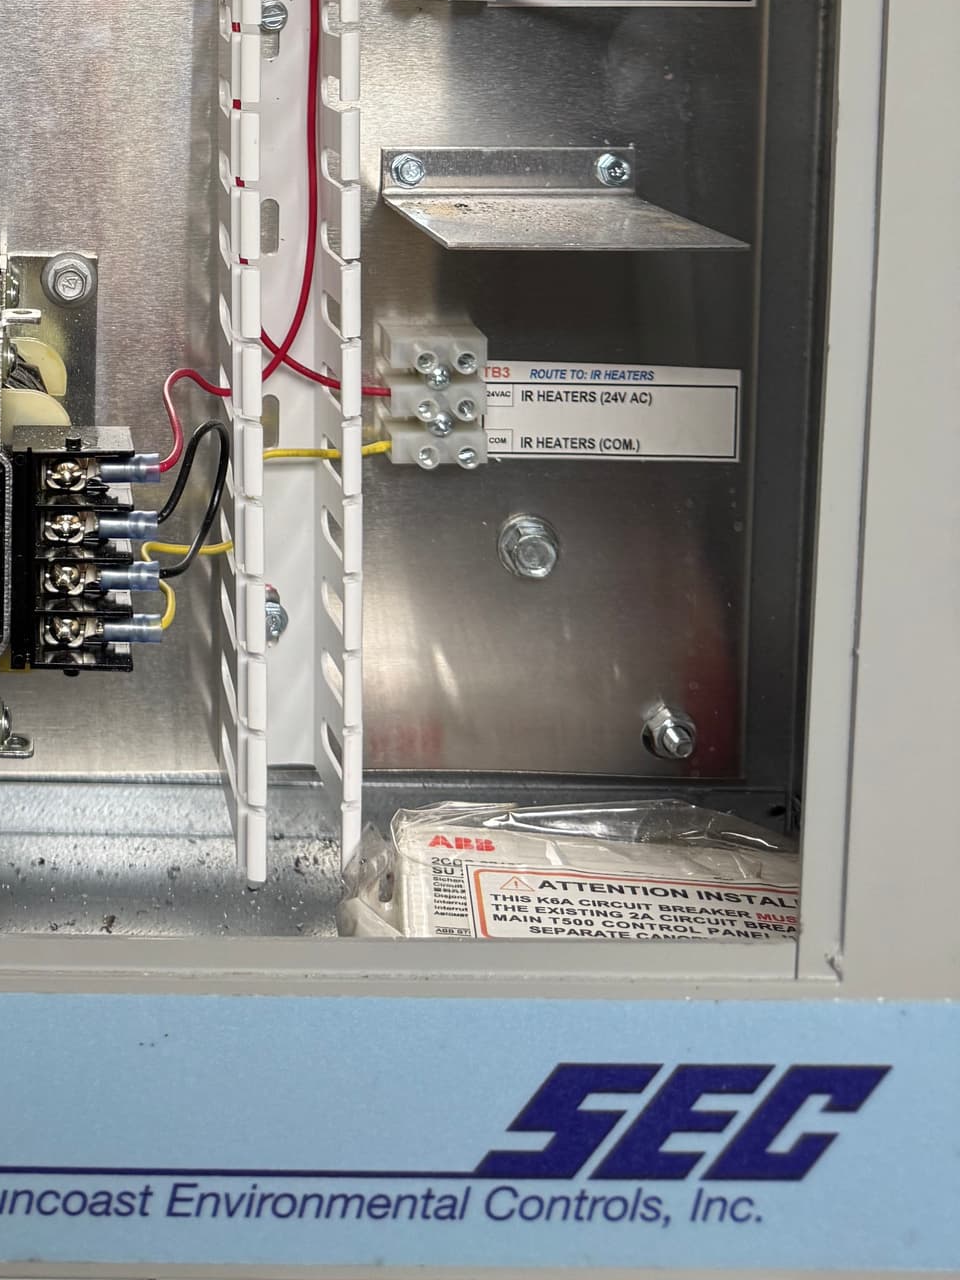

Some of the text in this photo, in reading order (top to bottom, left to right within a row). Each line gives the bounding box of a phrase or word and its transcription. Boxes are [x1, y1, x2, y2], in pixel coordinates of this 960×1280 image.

[483, 366, 655, 381] TB3 ROUTE TO: IR HEATERS
[486, 390, 652, 406] 24VAC IR HEATERS (24V AC)
[488, 436, 641, 452] COM IR HEATERS (COM.)
[428, 835, 496, 852] ABB
[538, 880, 689, 899] ATTENTION
[490, 894, 753, 919] THIS K6A CIRCUIT BREAKER
[491, 903, 737, 927] THE EXISTING 2A CIRCUIT
[493, 914, 702, 934] MAIN T500 CONTROL
[474, 1062, 893, 1181] SEC
[166, 1182, 470, 1220] Environmental
[484, 1186, 671, 1228] Controls,
[690, 1188, 763, 1223] Inc.
